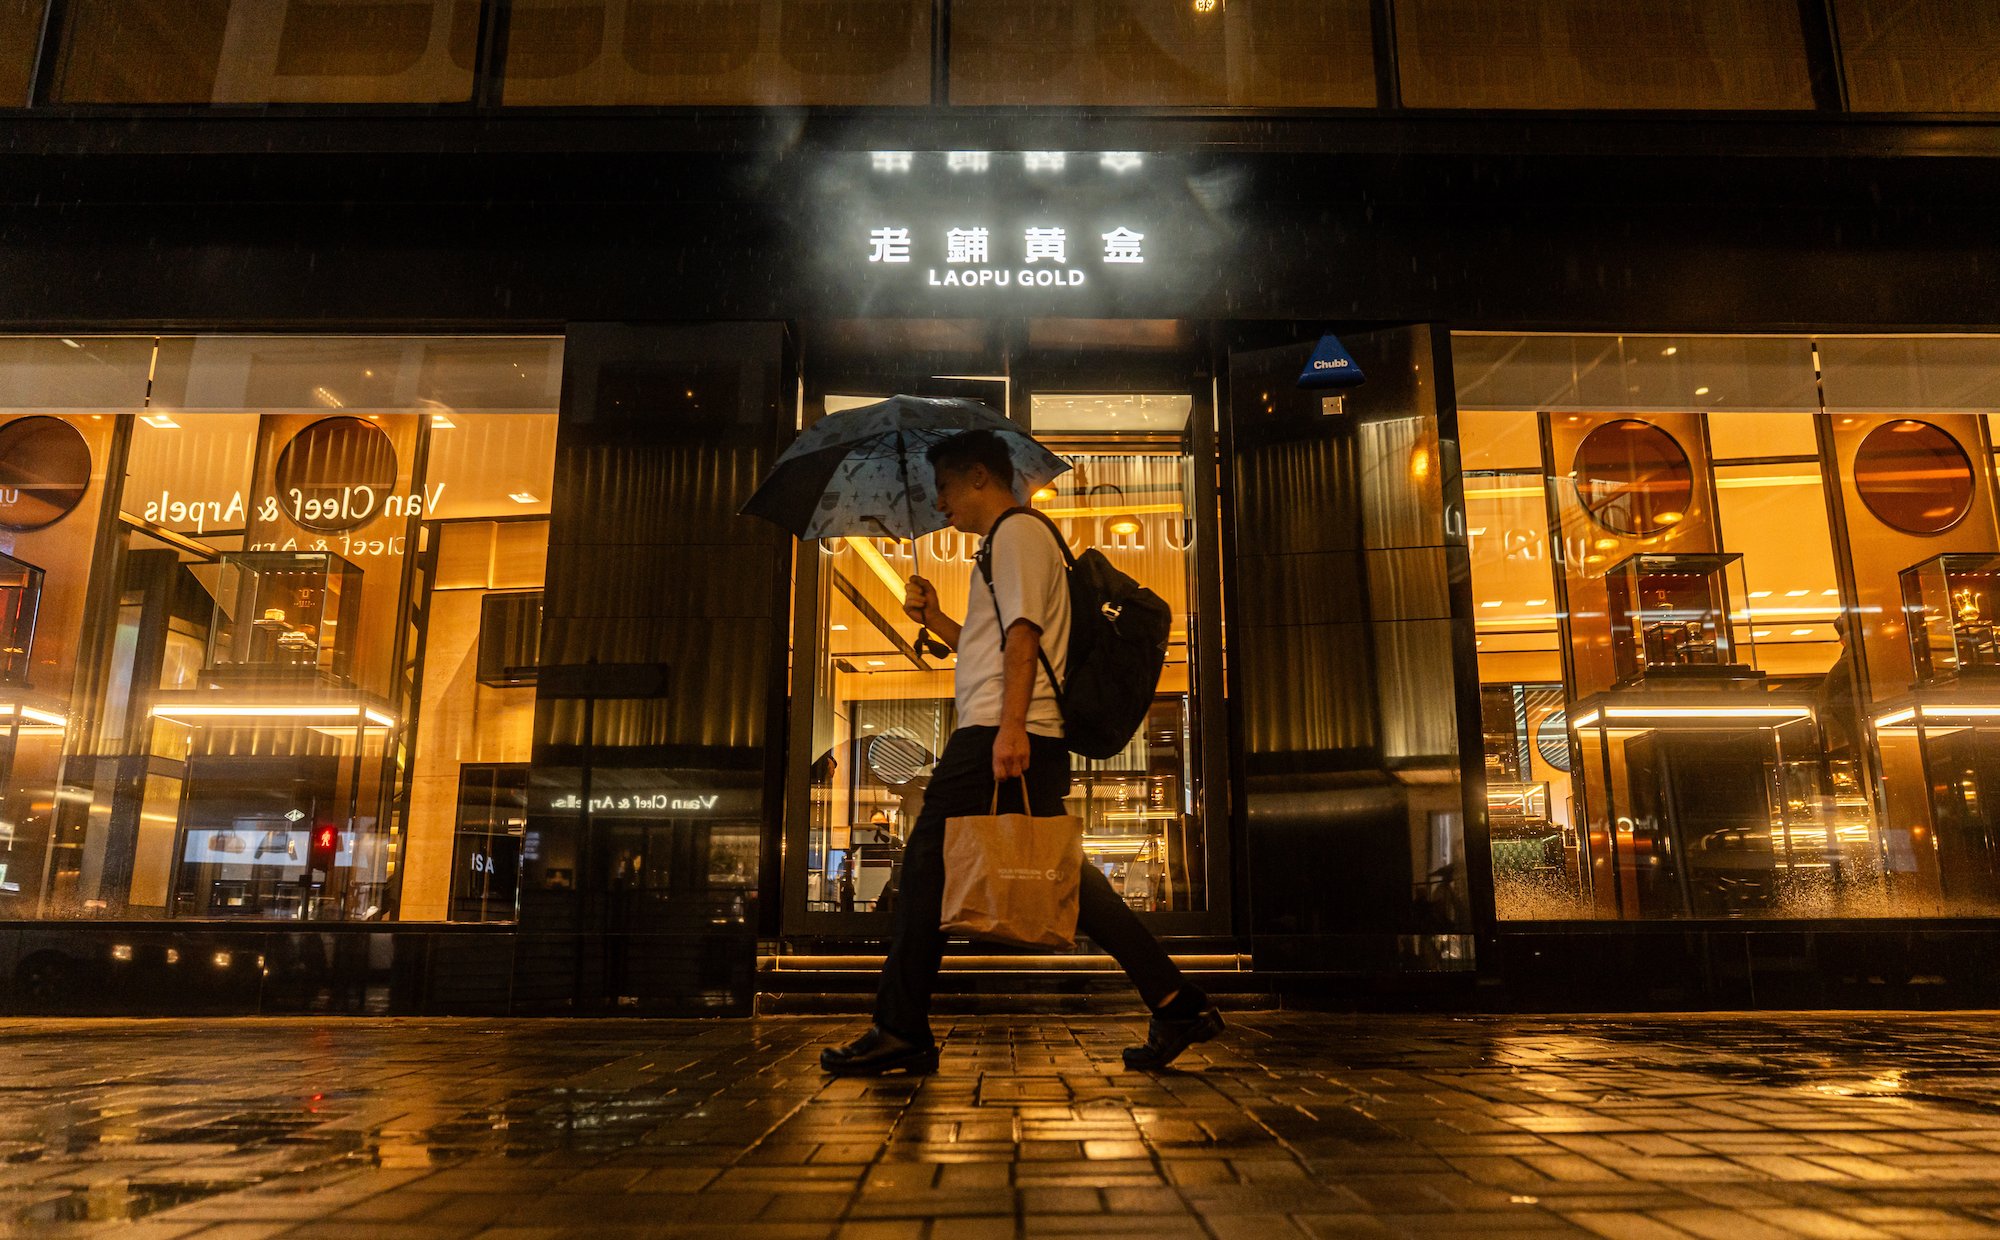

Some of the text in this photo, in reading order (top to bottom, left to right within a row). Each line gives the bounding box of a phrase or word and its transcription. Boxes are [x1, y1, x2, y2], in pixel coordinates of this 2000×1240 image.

[928, 269, 1085, 286] LAOPU GOLD
[1313, 359, 1349, 369] Chubb
